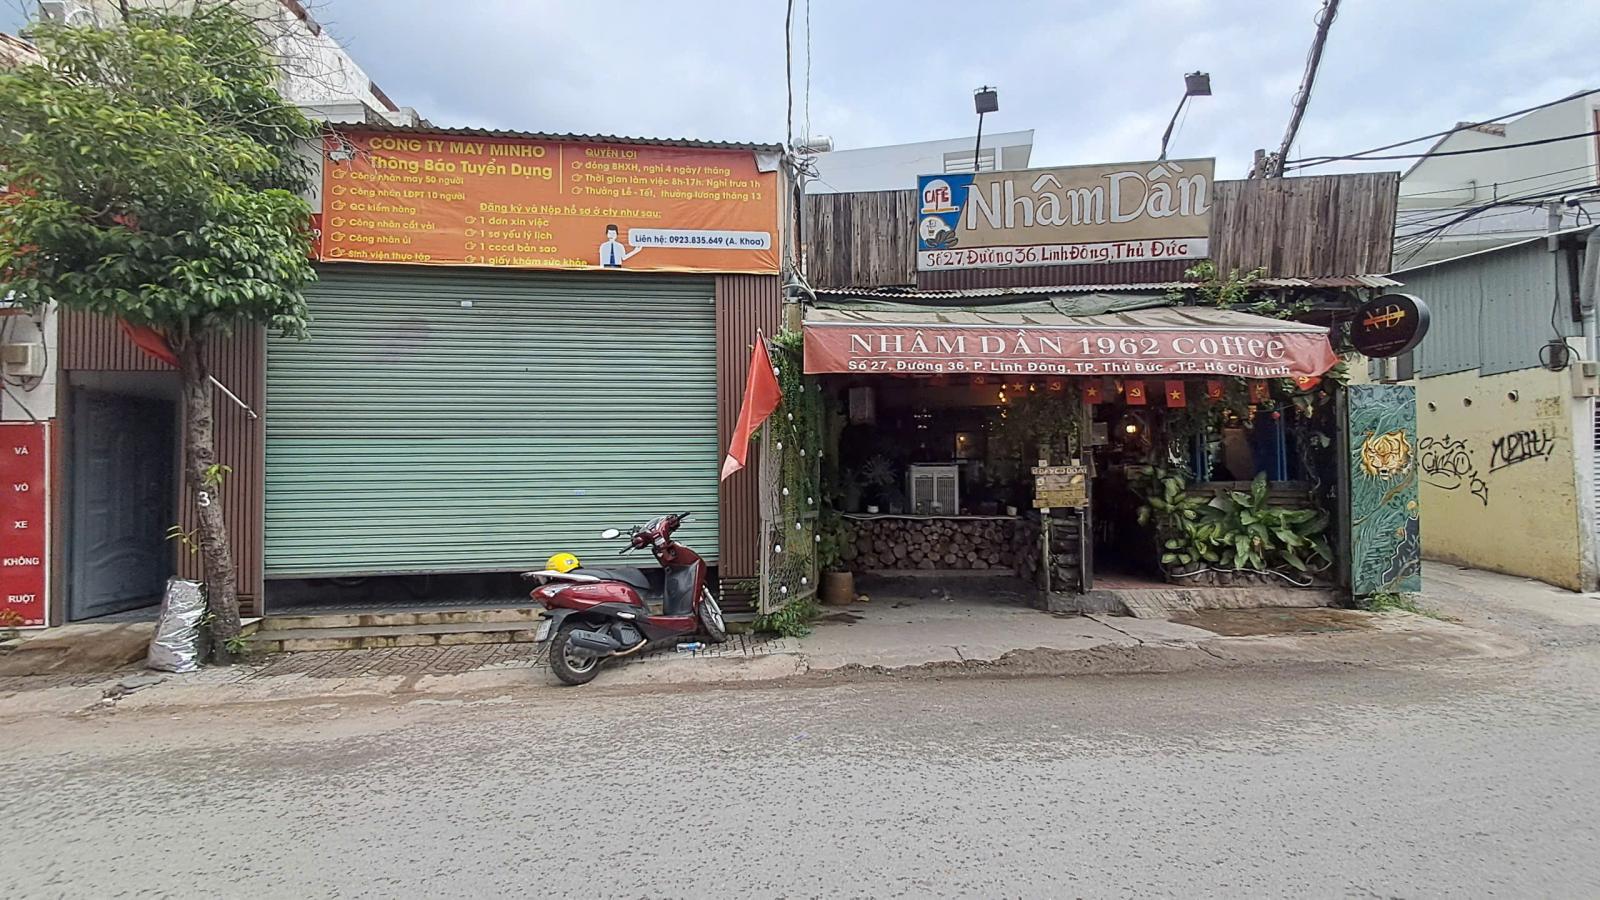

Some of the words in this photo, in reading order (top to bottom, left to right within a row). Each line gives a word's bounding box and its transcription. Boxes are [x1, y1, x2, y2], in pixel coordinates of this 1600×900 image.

[369, 135, 421, 151] CÔNG
[427, 140, 444, 153] TY
[449, 142, 485, 155] MAY
[490, 144, 545, 158] MINHO
[369, 156, 419, 173] Thông
[424, 159, 456, 172] Báo
[460, 158, 506, 176] Tuyển
[511, 163, 552, 180] Dụng
[585, 162, 610, 172] đóng
[612, 163, 641, 172] BHXH,
[704, 166, 731, 176] tháng
[350, 172, 376, 182] Công
[404, 175, 423, 184] may
[426, 175, 436, 183] 50
[439, 176, 464, 185] người
[606, 175, 628, 184] gian
[629, 175, 648, 184] làm
[650, 176, 669, 186] việc
[729, 180, 747, 188] trưa
[750, 180, 760, 188] 1h
[350, 187, 376, 197] Công
[427, 191, 438, 199] 10
[440, 192, 465, 201] người
[722, 191, 749, 201] tháng
[961, 173, 1106, 231] Nhâm
[1101, 160, 1213, 224] Dần
[392, 205, 416, 215] hàng
[480, 202, 508, 214] Đăng
[510, 203, 522, 214] ký
[525, 204, 538, 214] và
[541, 205, 561, 216] Nộp
[563, 204, 577, 214] hồ
[579, 207, 591, 215] sơ
[602, 207, 618, 217] cty
[620, 208, 639, 217] như
[349, 218, 375, 229] Công
[480, 216, 485, 224] 1
[511, 217, 526, 226] xin
[529, 217, 550, 228] việc
[349, 234, 375, 244] Công
[480, 229, 485, 237] 1
[488, 230, 500, 238] sơ
[502, 229, 521, 240] yếu
[523, 230, 532, 240] lý
[534, 230, 553, 241] lịch
[635, 234, 652, 243] Liên
[654, 235, 667, 245] hệ:
[669, 235, 723, 245] 0923.835.649
[725, 236, 738, 247] (A.
[740, 237, 765, 247] Khoa)
[480, 242, 485, 251] 1
[517, 242, 537, 253] bản
[539, 245, 557, 253] sao
[1112, 241, 1145, 259] Thủ
[1151, 239, 1188, 257] Đức
[348, 249, 368, 259] Sinh
[370, 250, 390, 261] viện
[480, 256, 485, 264] 1
[488, 255, 511, 266] giấy
[513, 256, 541, 266] khám
[848, 330, 967, 354] NHÂM
[979, 329, 1064, 354] DẦN
[1078, 336, 1161, 356] 1962
[848, 359, 867, 371] Số
[871, 360, 892, 372] 27,
[896, 359, 943, 374] Đường
[947, 361, 969, 372] 36,
[974, 361, 986, 371] P.
[991, 362, 1023, 372] Linh
[1028, 361, 1071, 374] Đông,
[1074, 362, 1098, 372] TP.
[1102, 360, 1131, 372] Thủ
[1135, 361, 1164, 372] Đức
[1177, 361, 1200, 371] TP.
[1204, 361, 1223, 371] Hồ
[1228, 363, 1250, 374] Chí
[1254, 365, 1290, 376] Minh
[14, 445, 29, 455] VÁ
[197, 491, 211, 507] 3
[14, 521, 28, 529] XE
[4, 556, 40, 566] KHÔNG
[8, 594, 36, 604] RUỘT
